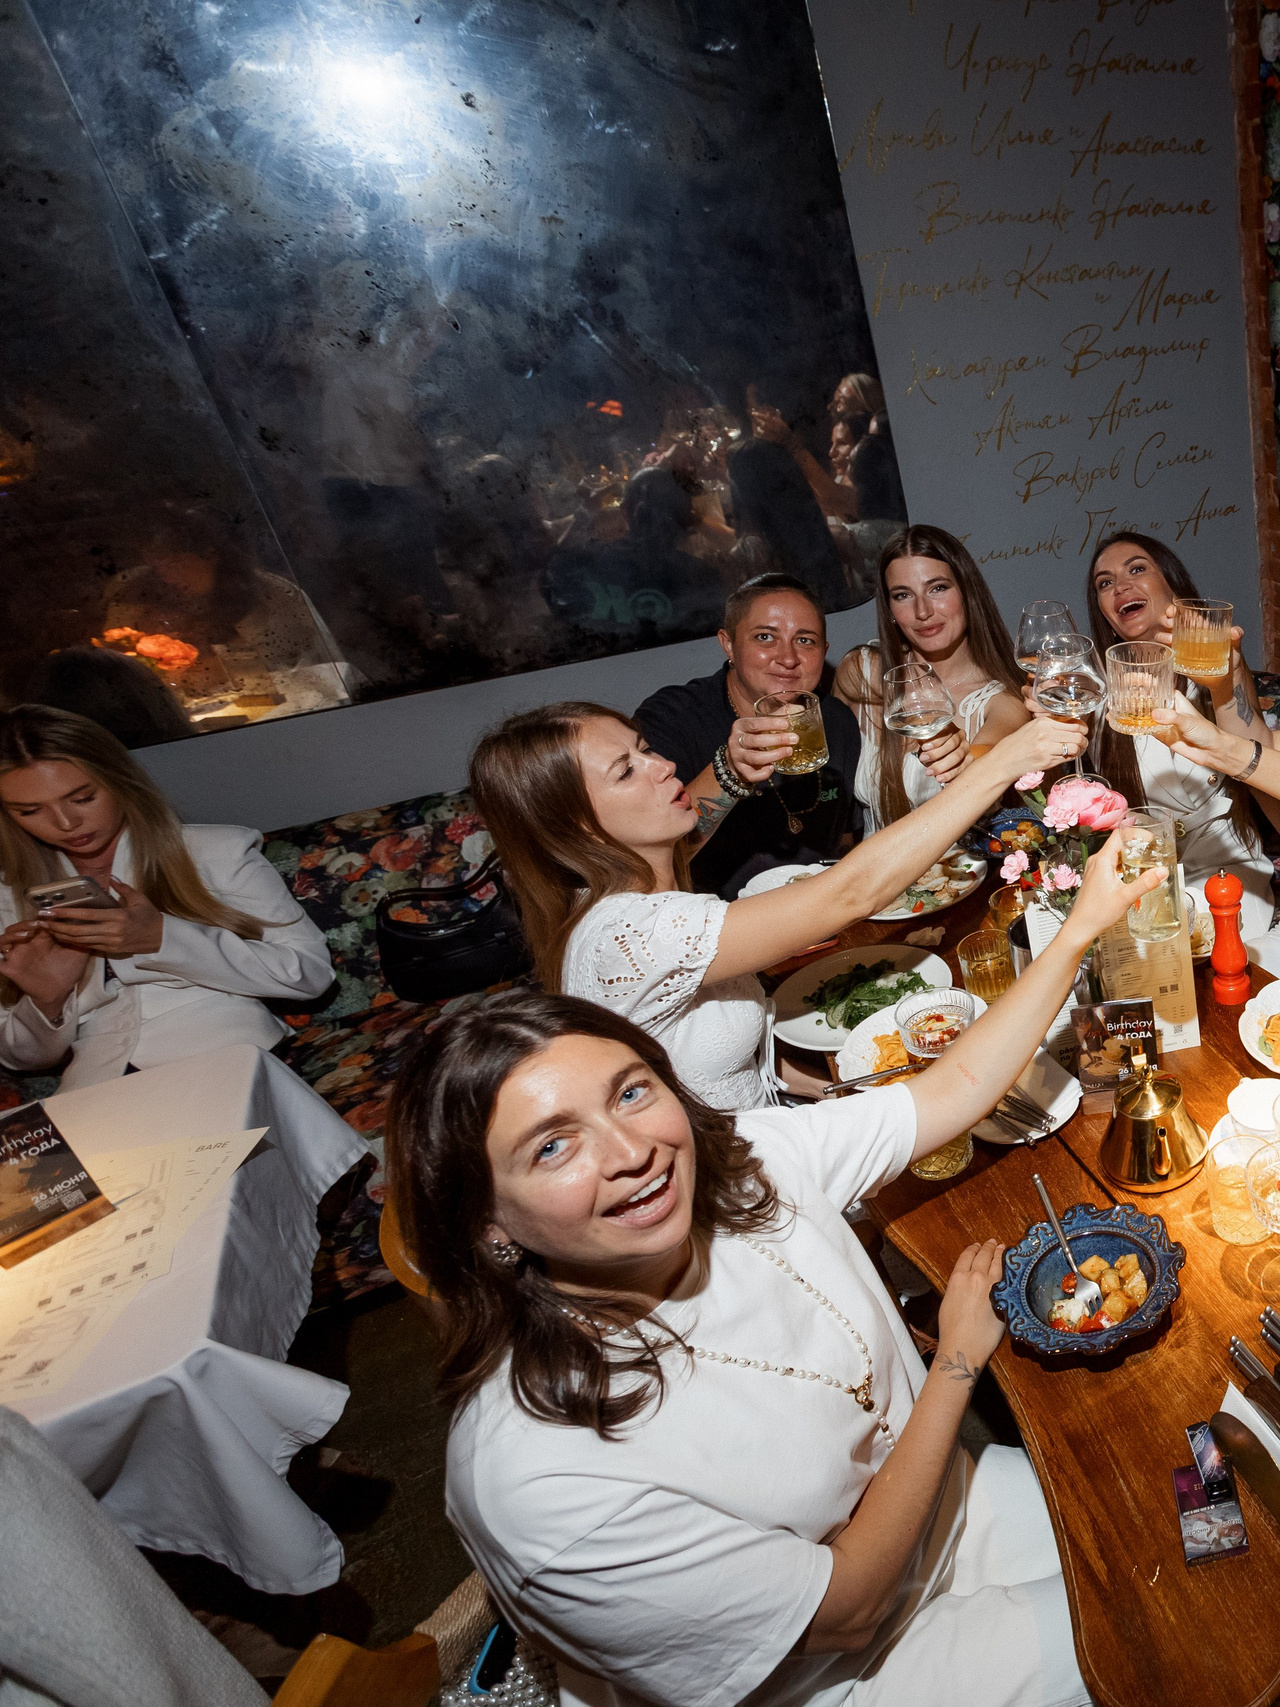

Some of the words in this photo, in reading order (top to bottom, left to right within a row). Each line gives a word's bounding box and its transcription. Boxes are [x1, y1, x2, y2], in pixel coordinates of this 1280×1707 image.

[1066, 27, 1204, 96] Наталья
[1070, 111, 1212, 179] Анастасия
[1087, 178, 1219, 241] Наталья
[1003, 243, 1143, 301] Константин
[1112, 267, 1222, 332] Мария
[1060, 323, 1209, 385] Владимир
[1087, 380, 1173, 441] Артём
[1012, 451, 1126, 504] Вакуров
[1133, 431, 1215, 488] Семён
[1175, 486, 1241, 542] Анна
[1106, 1020, 1153, 1032] Birthday
[1125, 1031, 1153, 1040] ГОДА
[1118, 1067, 1129, 1075] 26
[9, 1157, 19, 1166] 4
[20, 1138, 61, 1161] ГОДА
[31, 1193, 48, 1204] 26
[49, 1171, 88, 1195] ИЮНЯ
